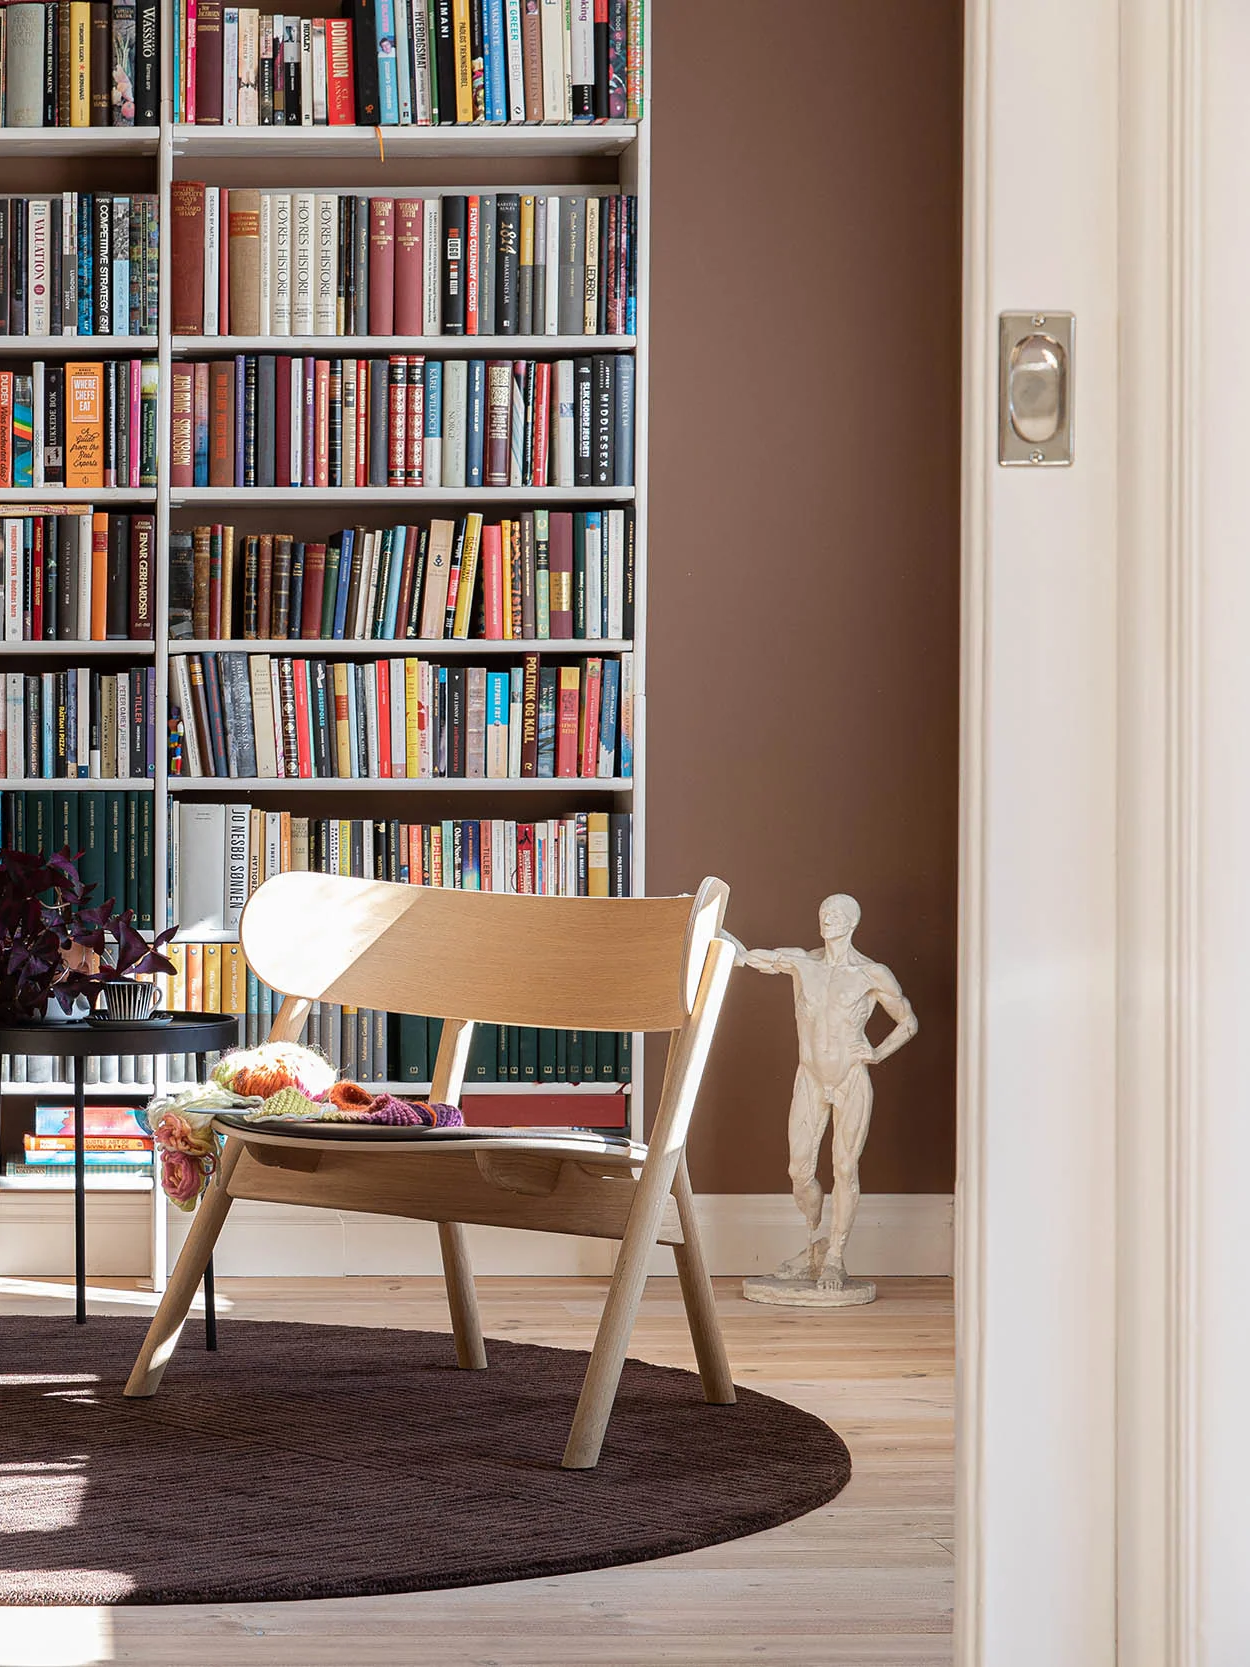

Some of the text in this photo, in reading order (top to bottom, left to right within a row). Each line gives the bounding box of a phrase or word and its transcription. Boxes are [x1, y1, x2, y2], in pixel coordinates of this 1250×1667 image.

[143, 7, 156, 58] WASSMO
[303, 23, 311, 53] HUXLEY
[414, 11, 427, 69] HVERDAGSMAT
[440, 0, 449, 39] IMANI
[510, 9, 521, 82] GREER THE BOY
[614, 16, 623, 31] food
[331, 21, 349, 78] DOMINION
[614, 41, 623, 55] italy
[209, 218, 215, 226] BY
[500, 221, 516, 255] 1814
[34, 219, 45, 280] VALUATION
[99, 205, 109, 313] COMPETITIVE STRATEGY
[277, 200, 288, 297] HØYRES HISTORIE
[298, 200, 309, 297] HØYRES HISTORIE
[320, 200, 331, 298] HØYRES HISTORIE
[469, 207, 478, 312] FLYING CULINARY CIRCUS
[587, 264, 596, 302] LEDEREN
[49, 391, 57, 408] BOK
[73, 379, 96, 389] WHERE
[75, 390, 95, 400] CHEFS
[79, 402, 91, 411] EAT
[429, 368, 438, 434] KÅRE WILLOCH
[581, 382, 590, 399] SLIK
[621, 375, 630, 428] JERUSALEM
[0, 374, 9, 483] DUDEN Was bedeutet das?
[49, 409, 57, 446] LUKKEDE
[174, 374, 191, 467] JOHN IRVING SIRKUSBARN
[581, 399, 590, 427] GJORDE
[581, 426, 590, 441] JEG
[599, 393, 609, 468] MIDDLESEX
[139, 532, 148, 620] EINAR GERHARDSEN
[525, 657, 538, 744] POLITIKK OG KALL
[59, 733, 67, 757] PIZZAN
[230, 809, 246, 909] JO NESBØ SØNNEN
